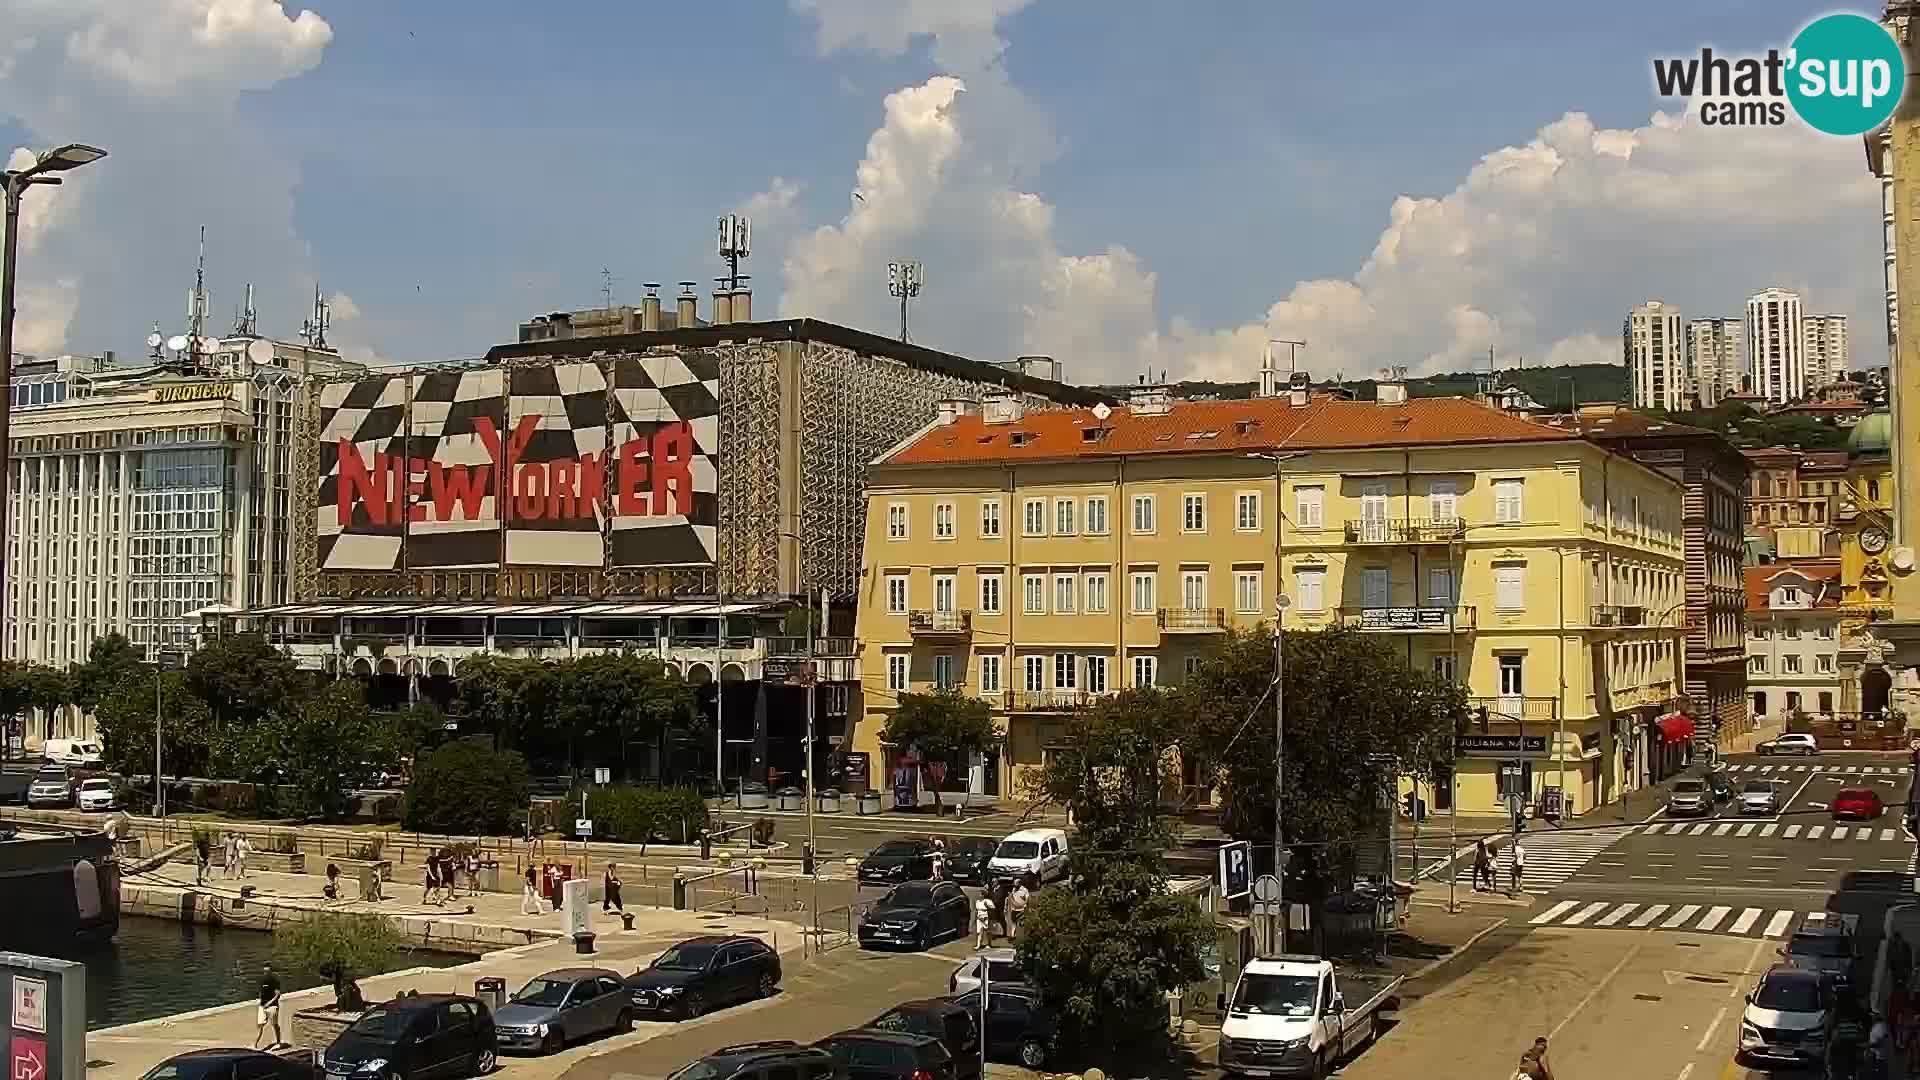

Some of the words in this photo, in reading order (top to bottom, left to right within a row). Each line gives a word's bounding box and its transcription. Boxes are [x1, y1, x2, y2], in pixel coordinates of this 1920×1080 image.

[337, 437, 491, 527] NEW
[474, 415, 693, 521] YORKER
[1460, 739, 1504, 747] JULIANA
[1508, 740, 1539, 748] NAILS
[1232, 850, 1243, 873] P
